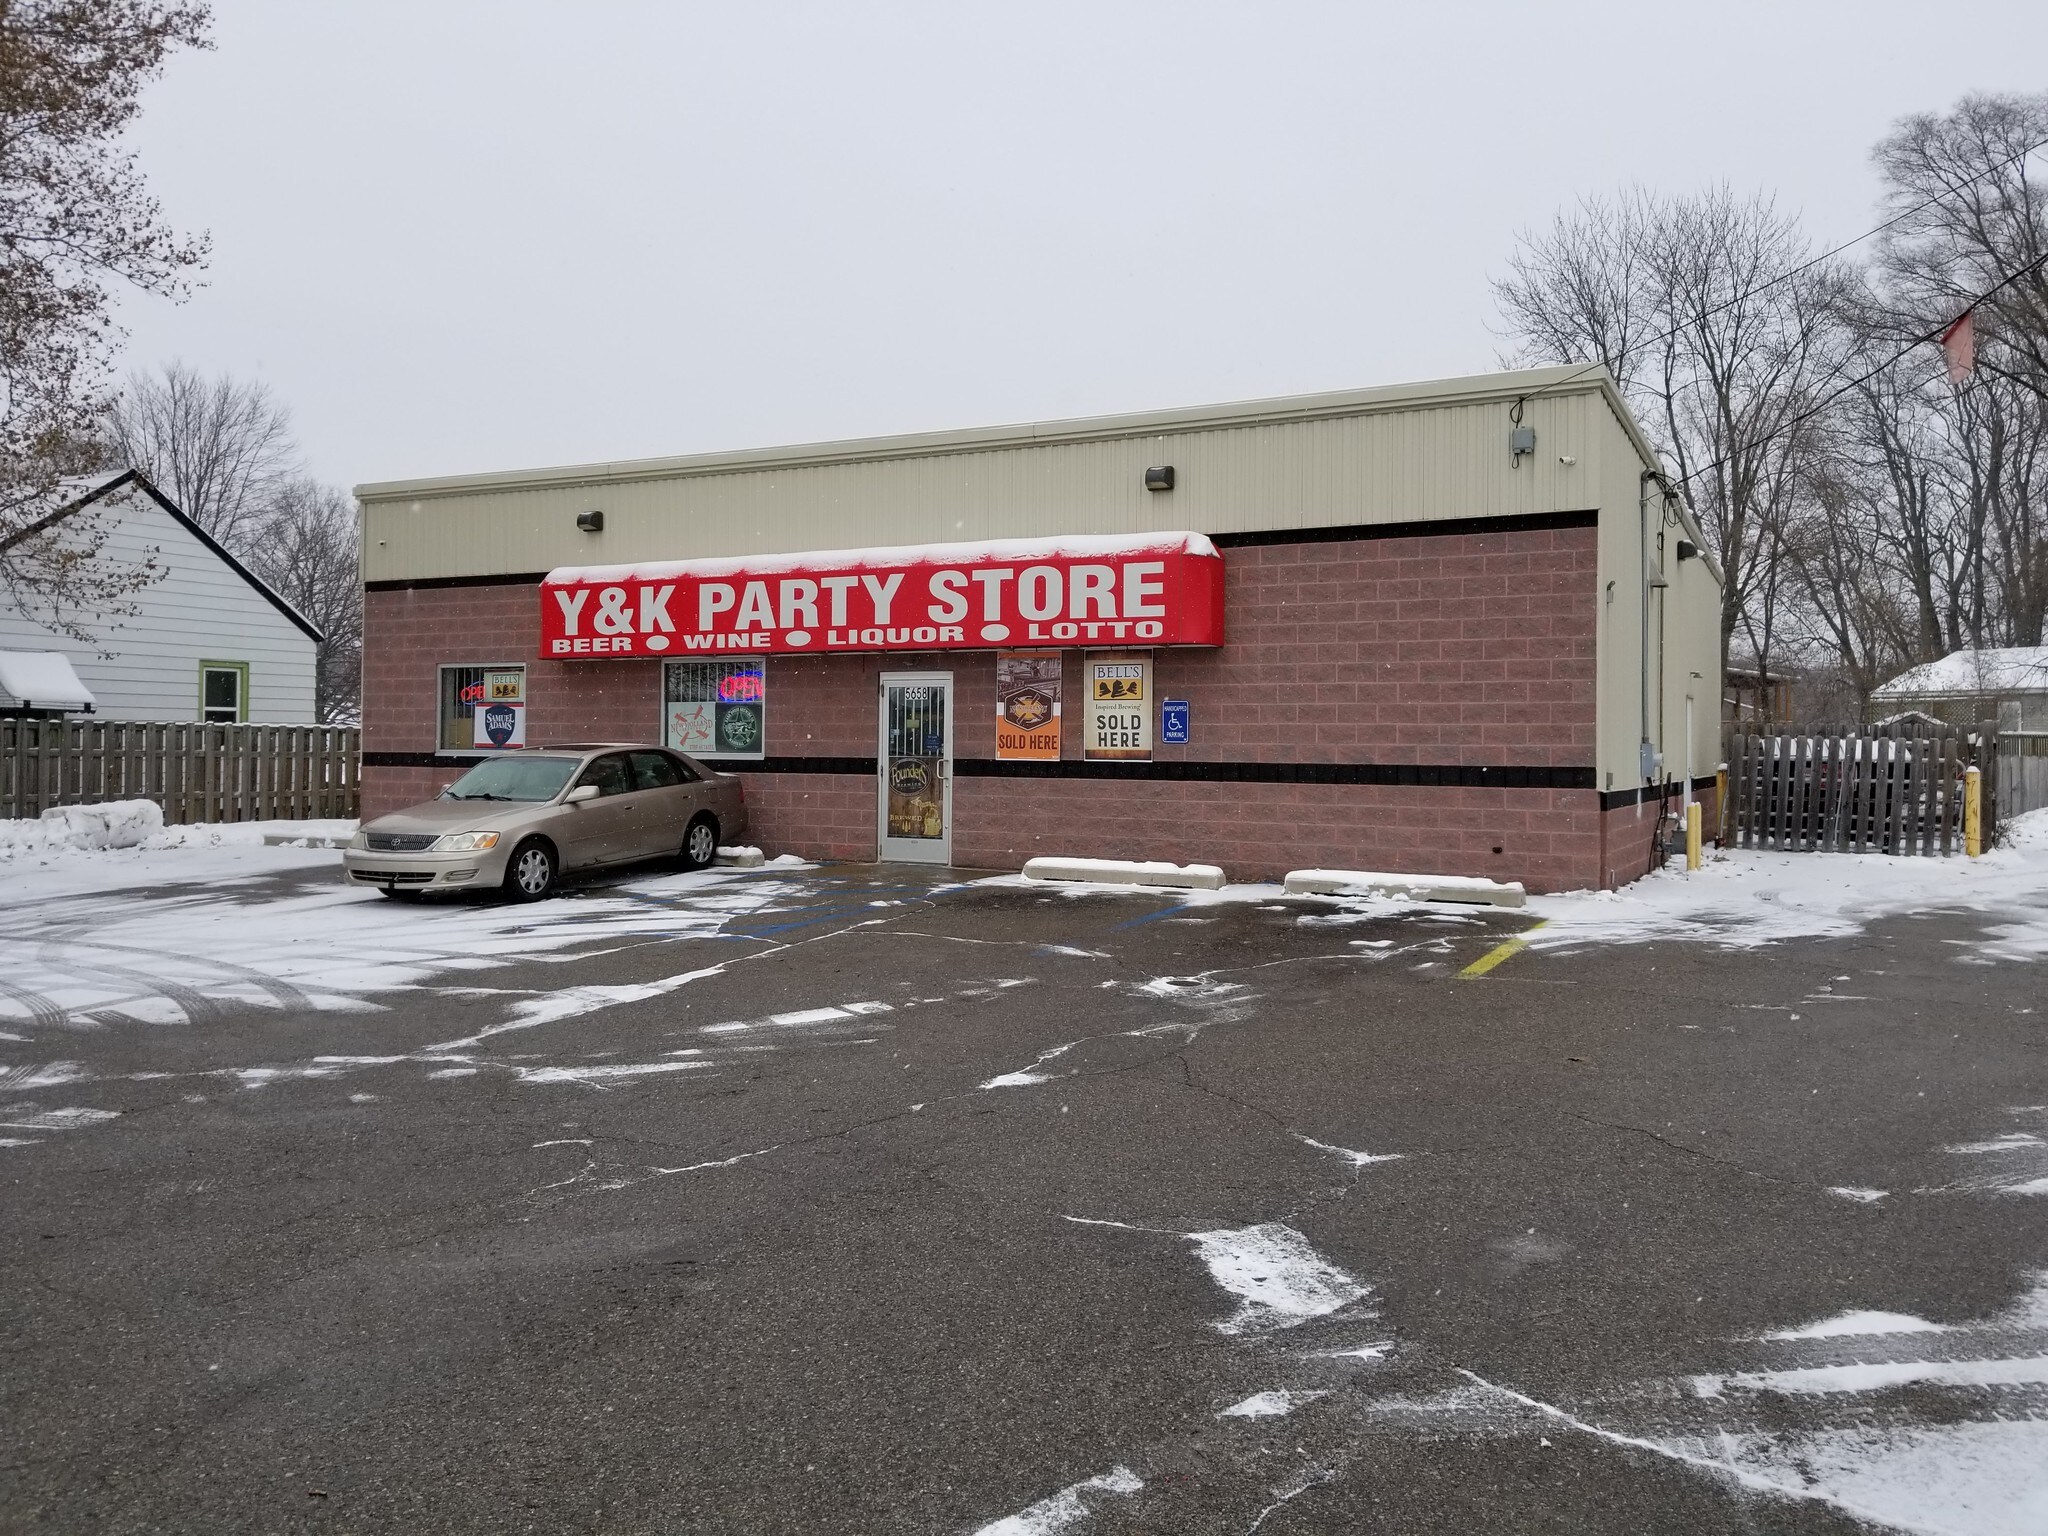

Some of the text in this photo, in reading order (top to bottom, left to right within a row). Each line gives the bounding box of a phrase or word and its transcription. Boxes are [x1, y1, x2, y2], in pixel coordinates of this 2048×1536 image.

[554, 562, 1166, 636] Y&K PARTY STORE
[552, 620, 1164, 653] BEER WINE LIQUOR LOTTO
[460, 686, 486, 701] OPE
[721, 677, 763, 698] OPEN
[905, 688, 928, 700] 5658
[1095, 703, 1142, 711] Inspired Brewing
[486, 713, 515, 723] SAMUEL
[1097, 715, 1141, 730] SOLD
[488, 722, 513, 731] ADAMS
[999, 735, 1058, 750] SOLD HERE
[1098, 732, 1140, 747] HERE
[892, 764, 927, 786] Founders
